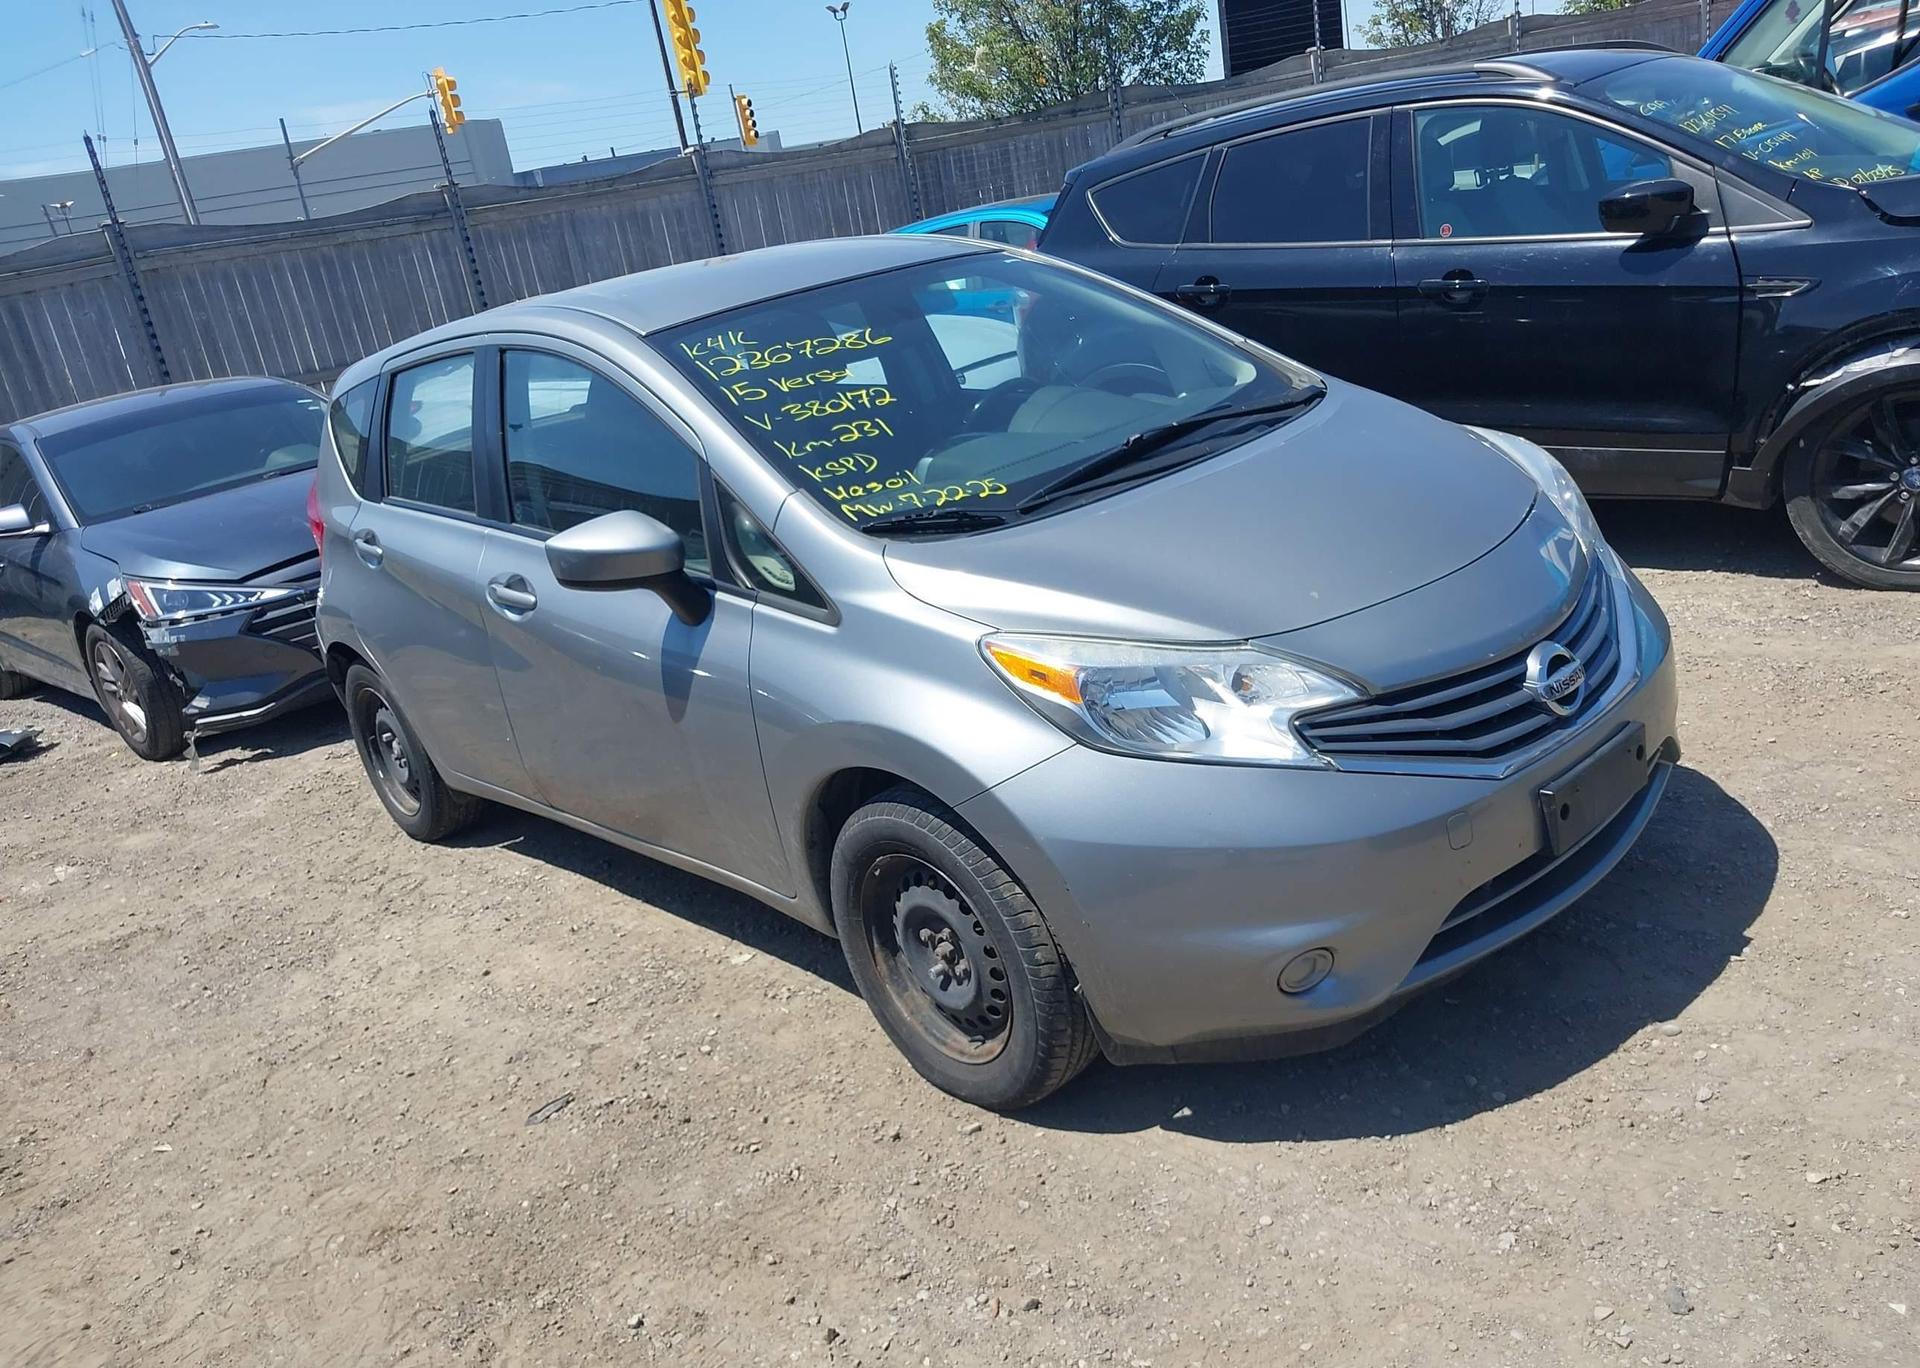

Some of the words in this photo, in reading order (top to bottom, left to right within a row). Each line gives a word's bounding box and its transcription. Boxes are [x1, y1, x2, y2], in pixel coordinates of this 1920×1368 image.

[1714, 134, 1737, 149] 17
[695, 327, 893, 381] 12367286
[720, 381, 768, 406] 15
[767, 368, 855, 393] Versa
[1550, 667, 1584, 696] NISSAN
